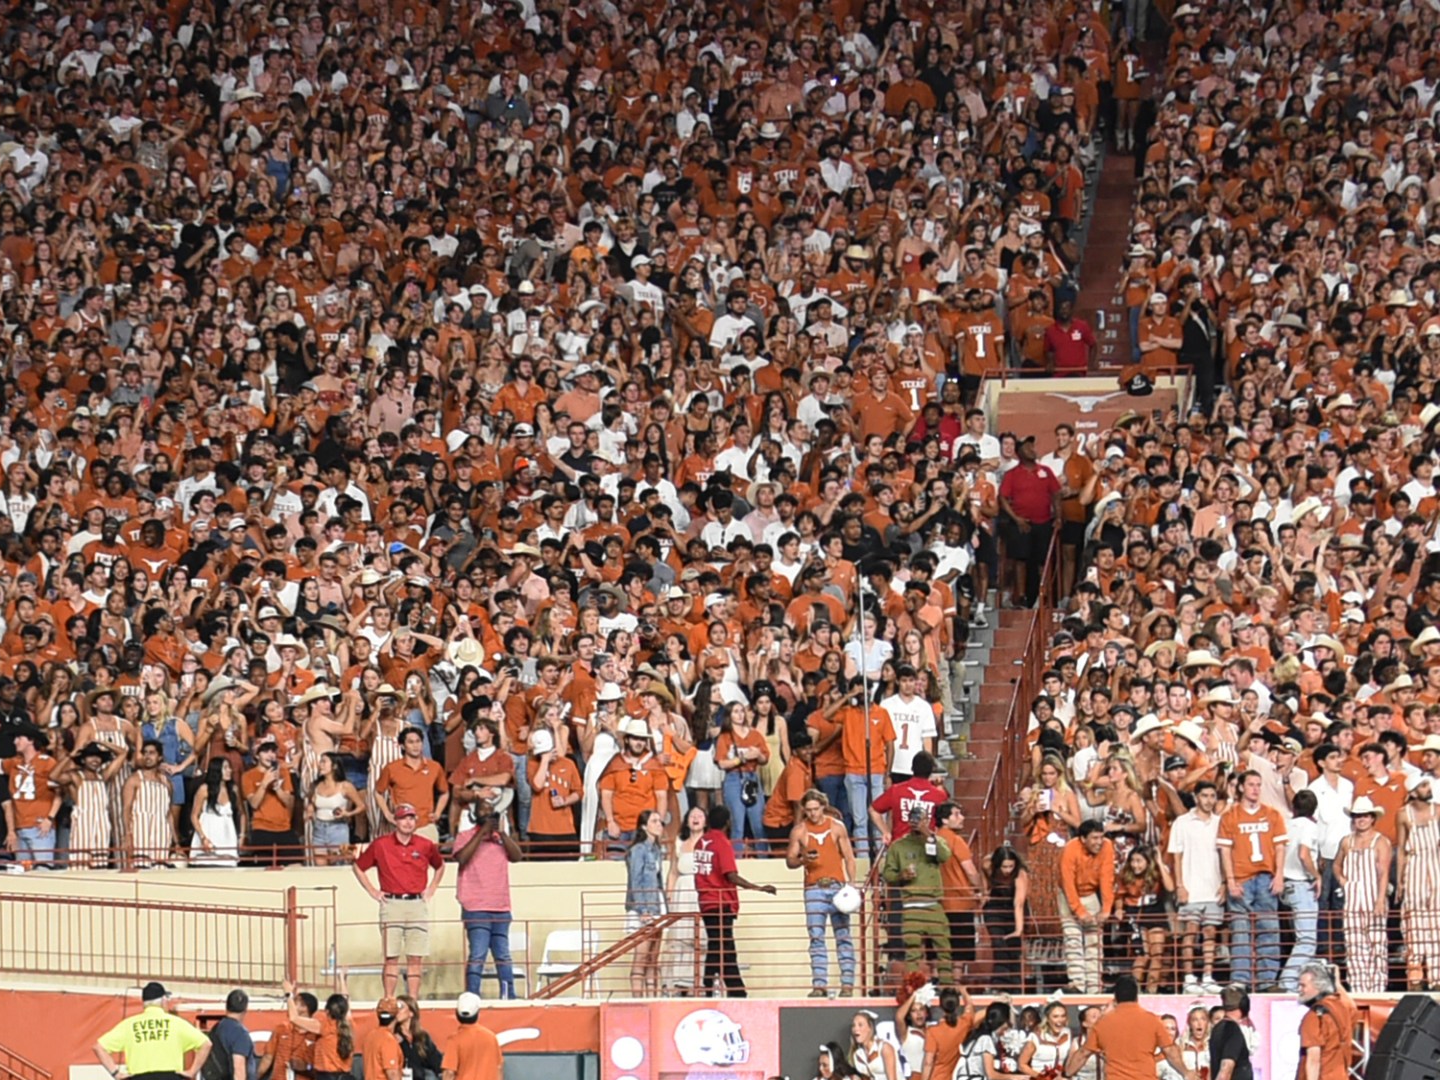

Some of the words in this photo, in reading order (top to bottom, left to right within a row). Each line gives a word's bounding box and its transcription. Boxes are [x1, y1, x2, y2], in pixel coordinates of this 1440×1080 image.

[1111, 297, 1123, 305] 40
[968, 325, 992, 334] TEXAS
[975, 334, 986, 358] 1
[1102, 345, 1114, 354] 37
[901, 380, 926, 389] TEXAS
[910, 388, 920, 411] 1
[1052, 612, 1065, 623] 27
[894, 713, 919, 723] TEXAS
[899, 723, 909, 750] 1
[901, 798, 935, 814] EVENT
[1238, 822, 1269, 834] TEXAS
[1250, 833, 1263, 862] 1
[132, 1019, 171, 1033] EVENT
[134, 1030, 170, 1043] STAFF
